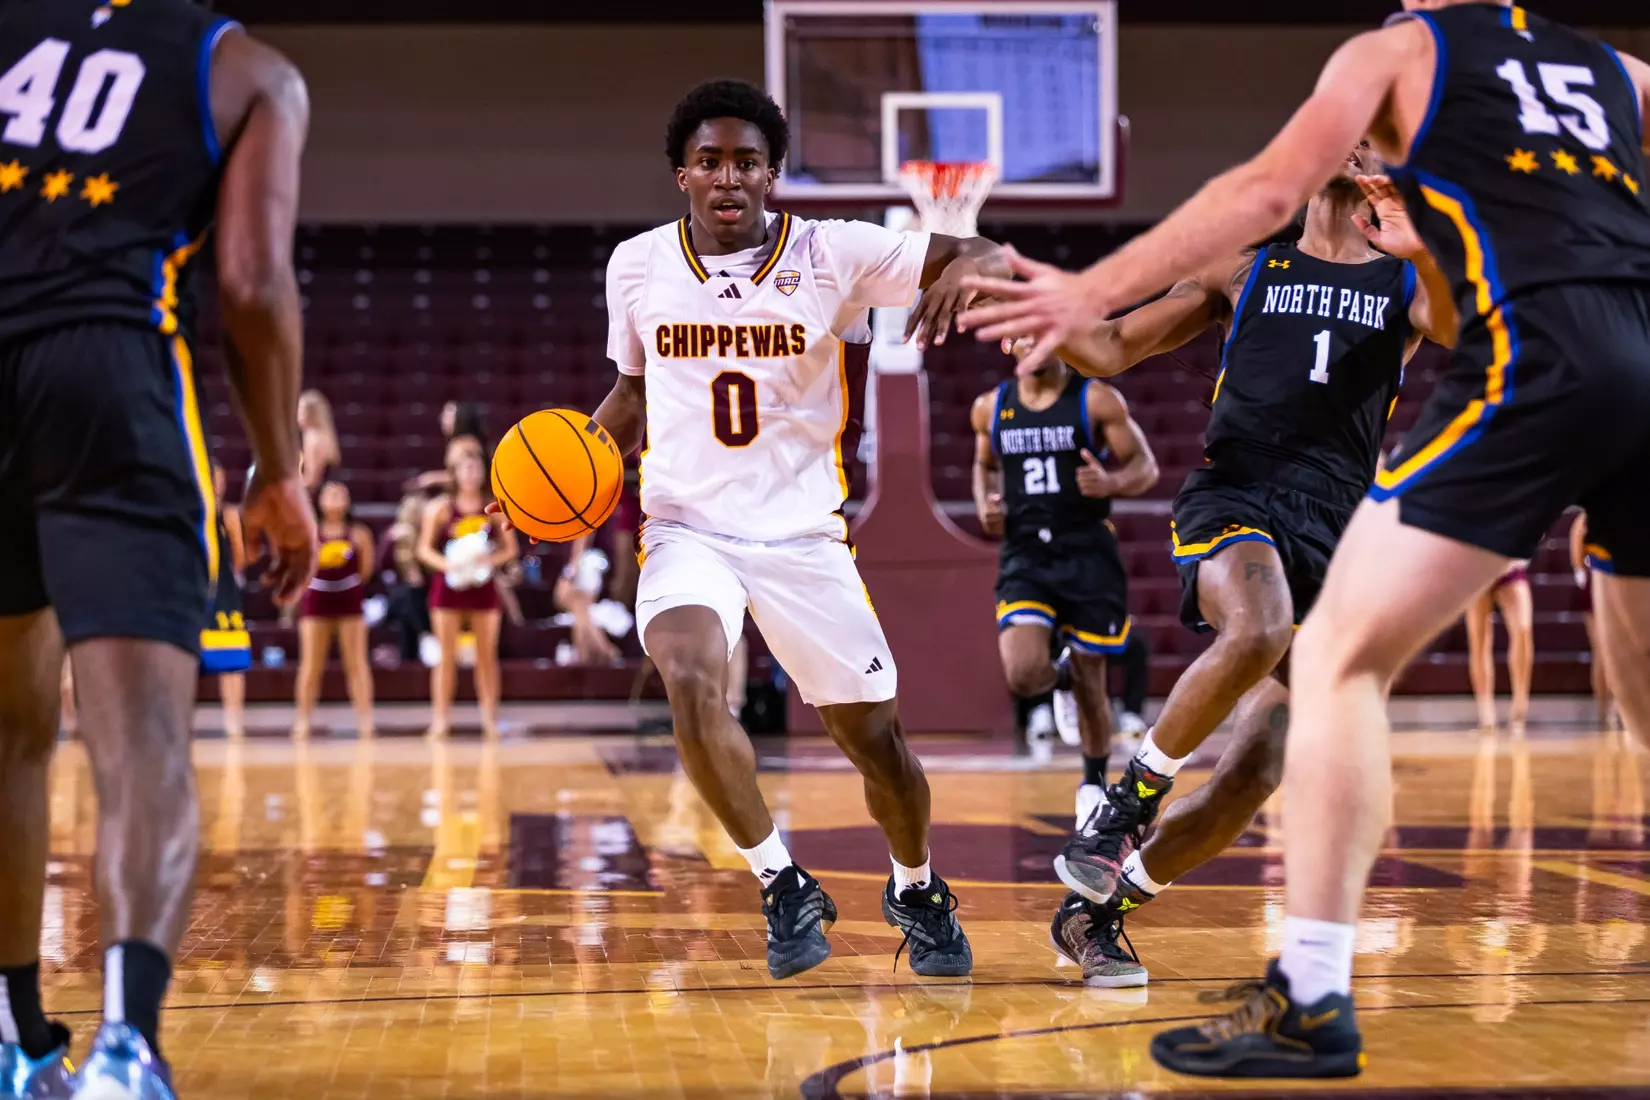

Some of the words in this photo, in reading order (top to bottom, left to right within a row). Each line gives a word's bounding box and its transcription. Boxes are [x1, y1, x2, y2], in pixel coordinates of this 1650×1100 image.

[0, 36, 147, 154] 40
[1496, 58, 1611, 150] 15
[775, 277, 800, 286] MAC
[1262, 284, 1334, 317] NORTH
[1337, 288, 1390, 330] PARK
[656, 324, 806, 358] CHIPPEWAS
[1309, 330, 1331, 384] 1
[710, 370, 760, 449] 0
[1000, 427, 1043, 454] NORTH
[1042, 426, 1076, 451] PARK
[1023, 456, 1061, 495] 21
